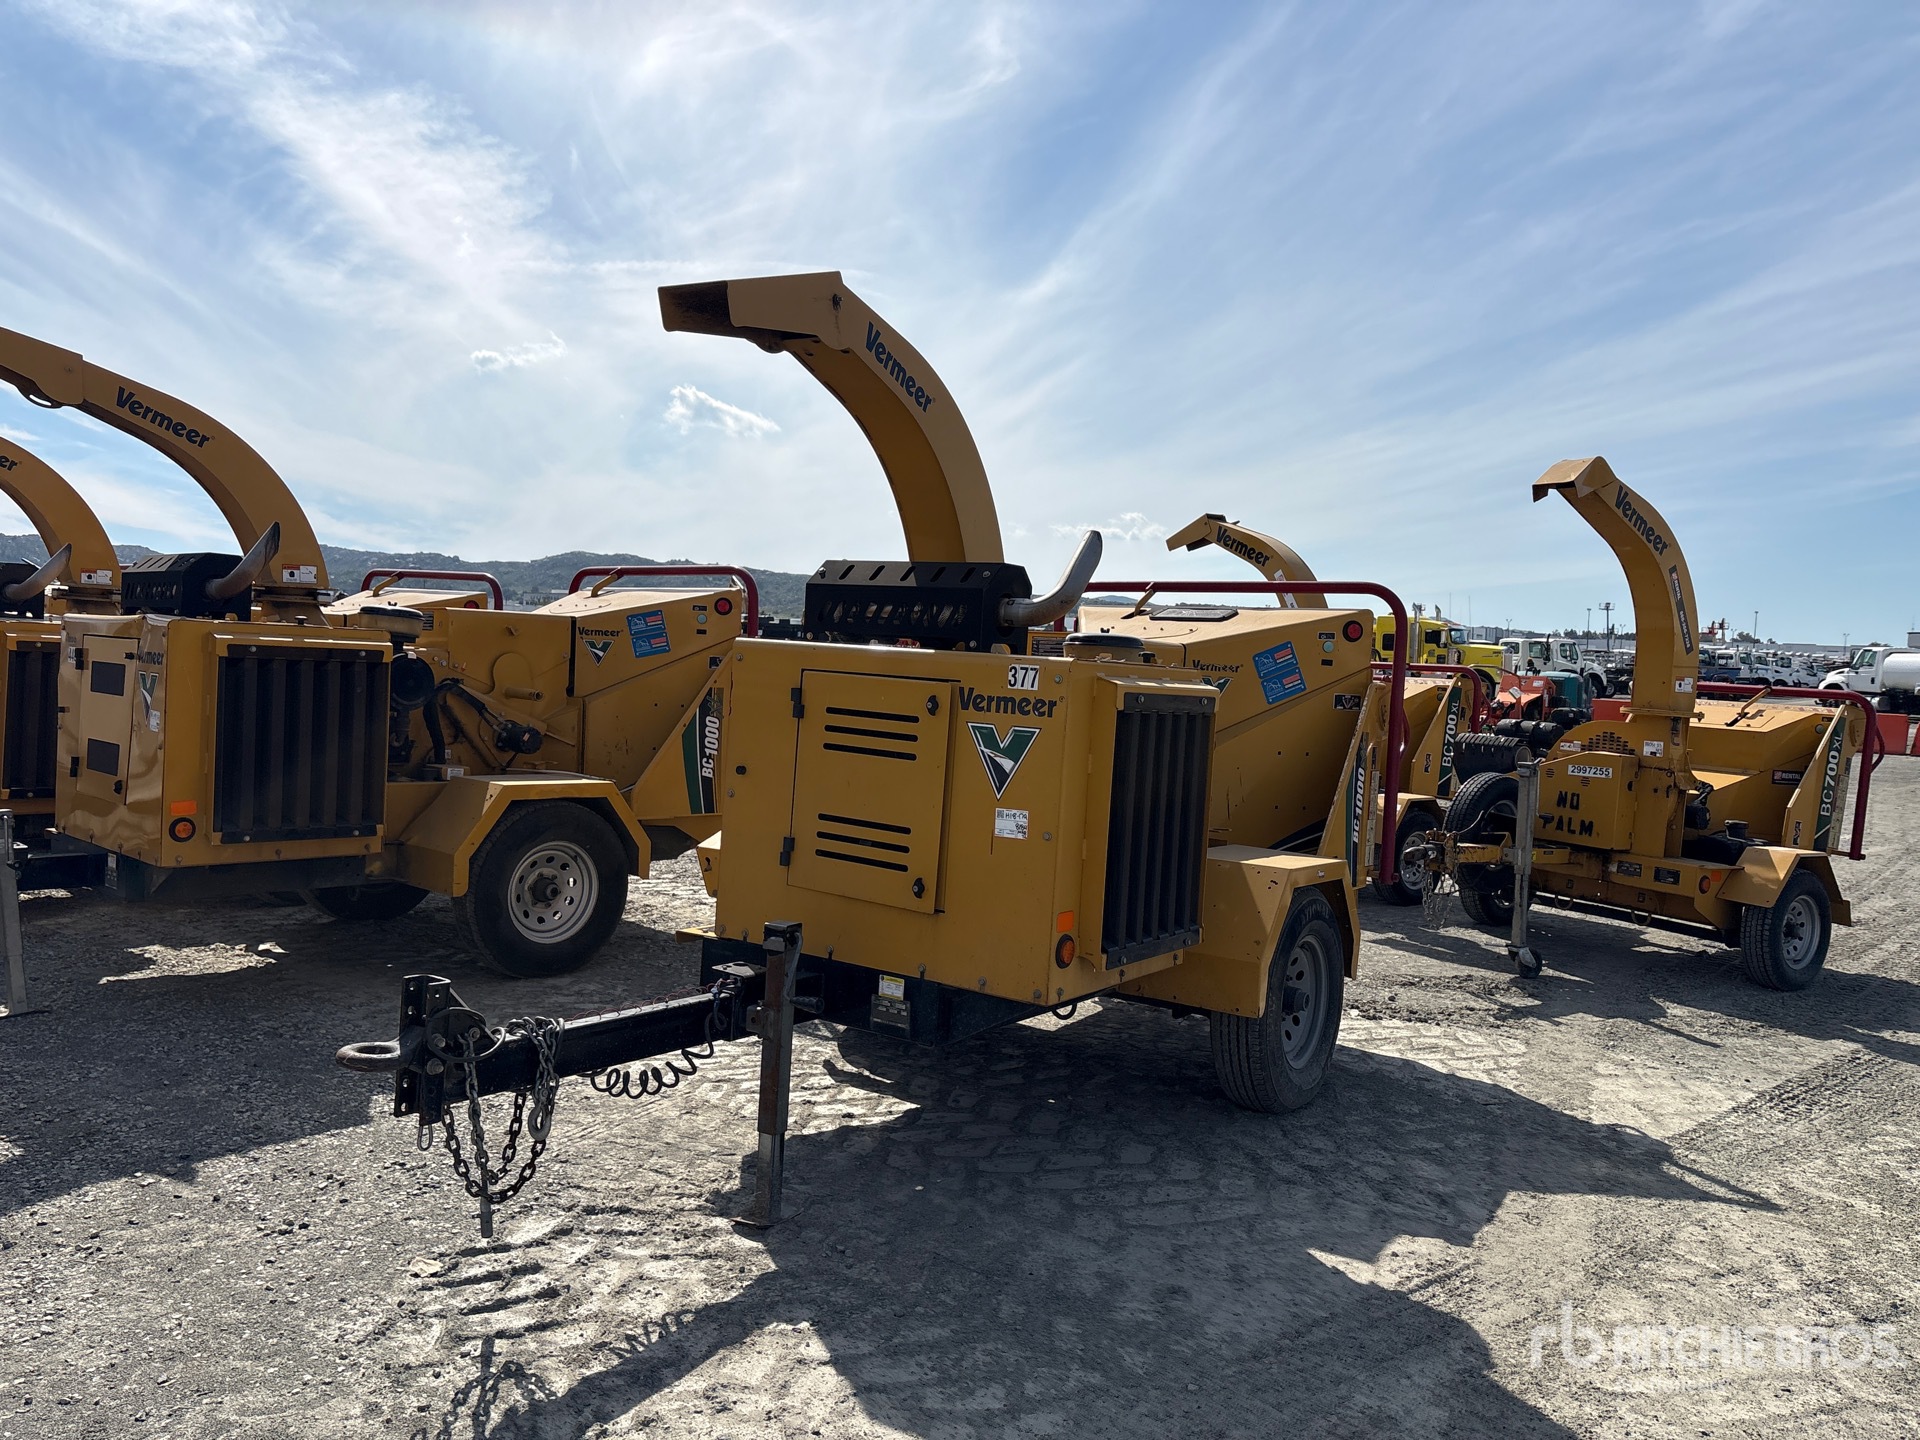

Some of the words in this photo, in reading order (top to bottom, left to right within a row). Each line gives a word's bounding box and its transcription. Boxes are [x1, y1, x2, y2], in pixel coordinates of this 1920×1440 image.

[865, 320, 933, 413] Vermeer
[115, 385, 210, 448] Vermeer
[1615, 484, 1669, 556] Vermeer
[1215, 525, 1270, 567] Vermeer
[577, 626, 621, 637] Vermeer
[1008, 665, 1040, 689] 377
[1191, 659, 1240, 673] Vermeer
[958, 686, 1058, 718] Vermeer
[1570, 765, 1611, 777] 2997255
[1556, 790, 1580, 811] NO
